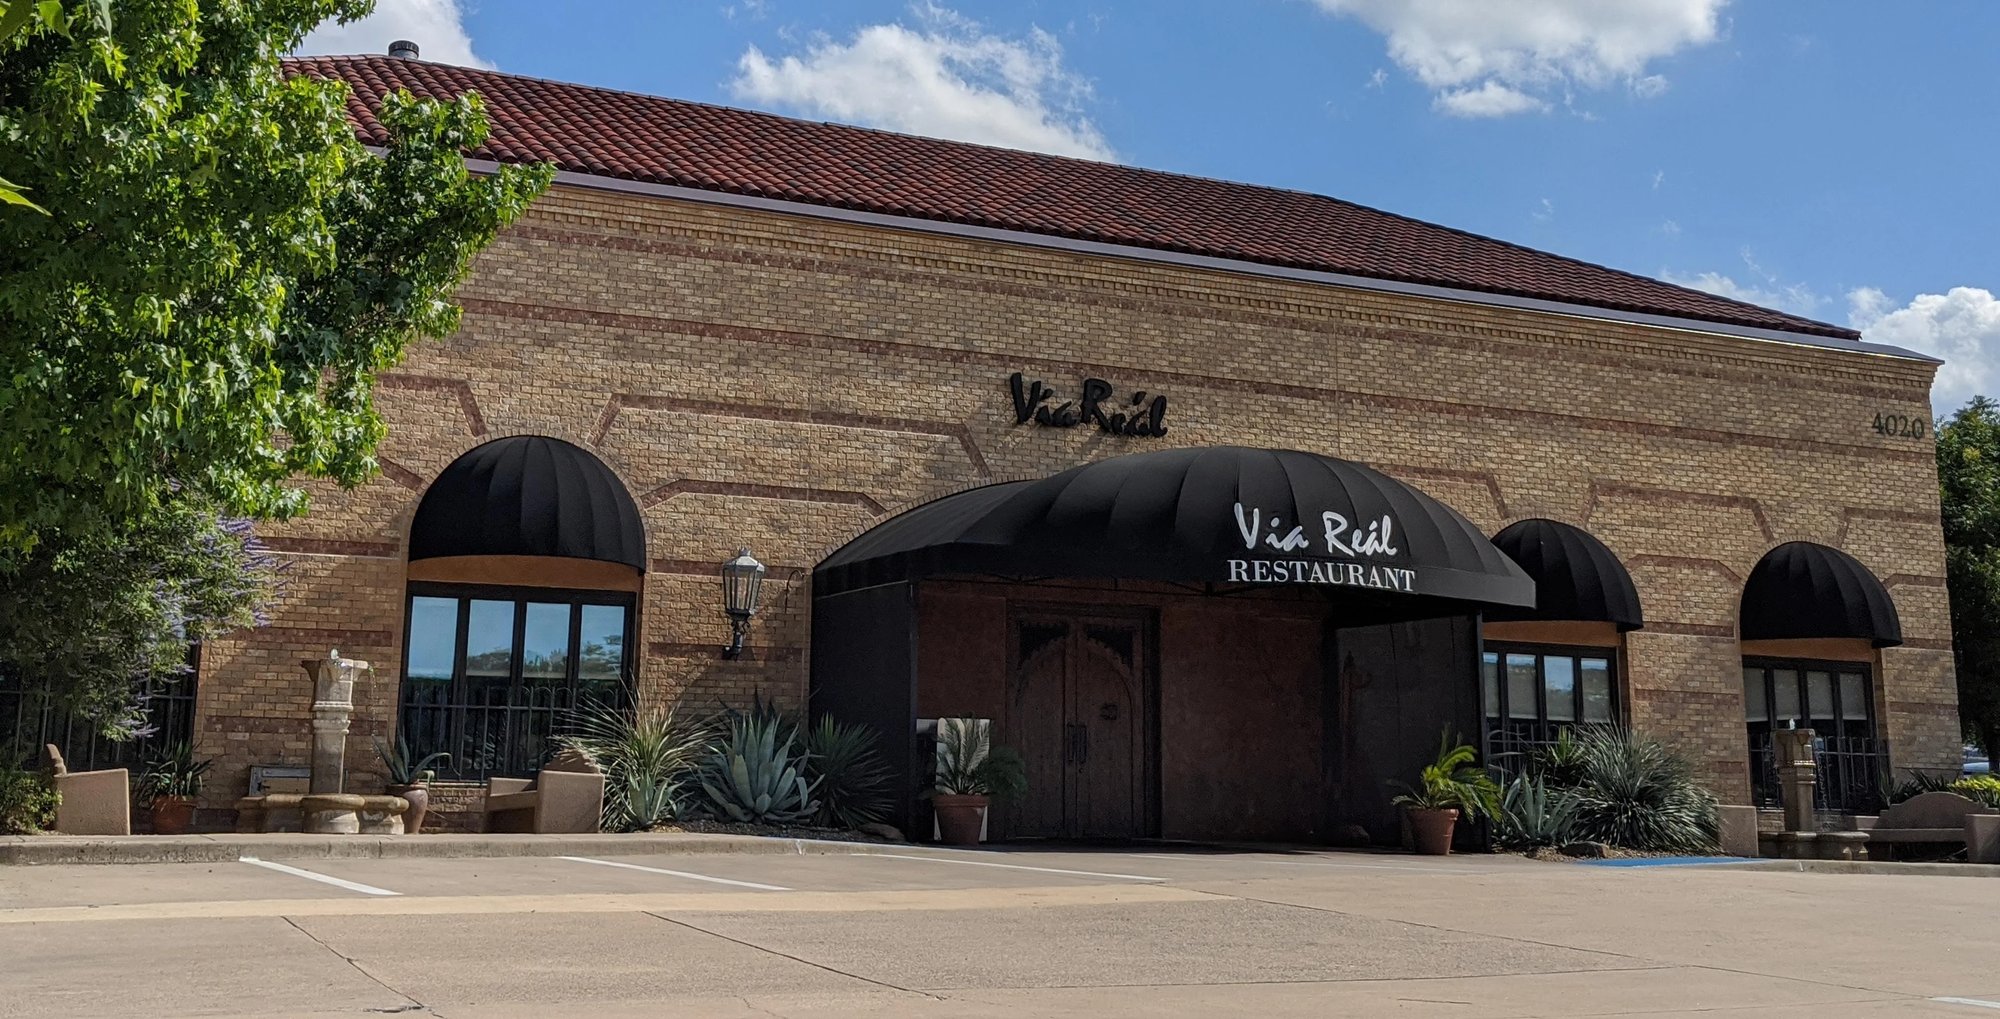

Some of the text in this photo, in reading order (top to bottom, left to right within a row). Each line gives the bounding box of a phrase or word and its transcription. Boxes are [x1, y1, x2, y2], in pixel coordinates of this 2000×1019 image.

[1010, 372, 1081, 427] Via
[1872, 412, 1925, 440] 4020
[1234, 502, 1397, 556] Via Reál
[1227, 559, 1416, 592] RESTAURANT
